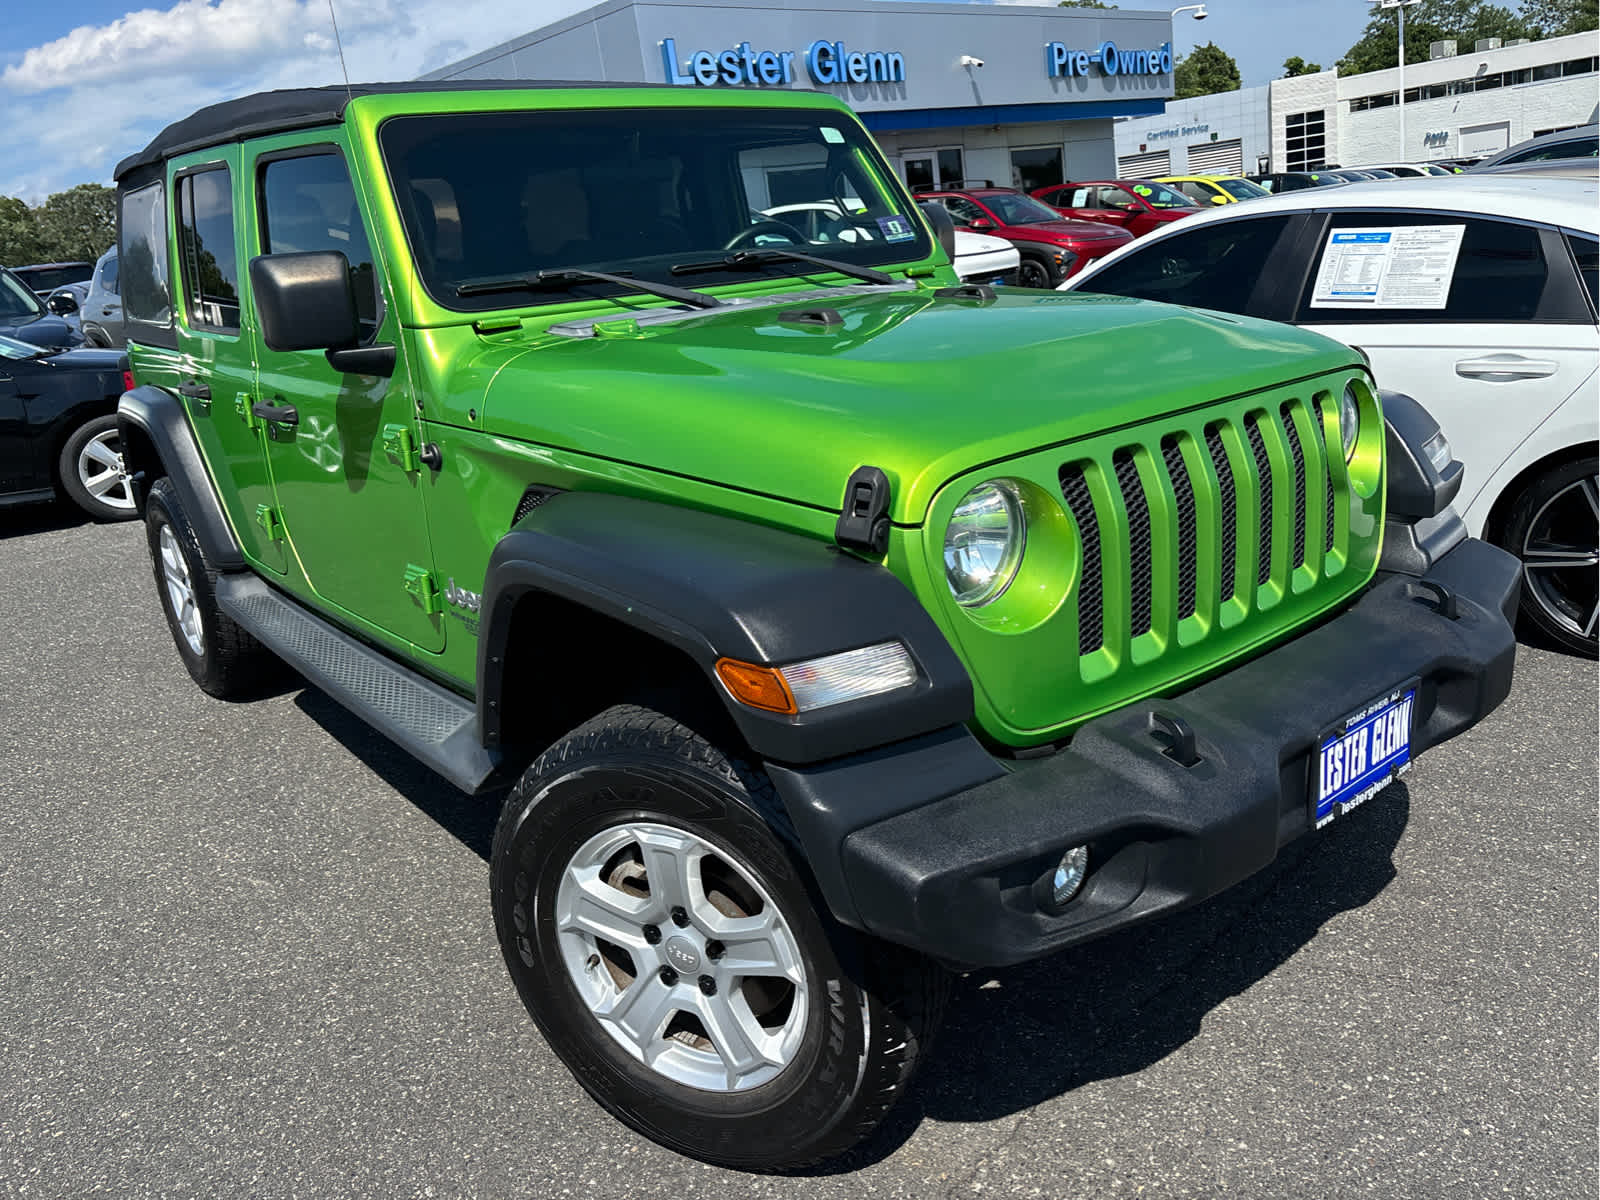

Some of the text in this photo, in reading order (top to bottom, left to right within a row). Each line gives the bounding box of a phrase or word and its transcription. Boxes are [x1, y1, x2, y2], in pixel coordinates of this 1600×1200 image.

[662, 38, 906, 87] Lester Glenn
[1047, 41, 1173, 77] Pre-Owned
[1146, 124, 1209, 141] Certified Service
[1345, 710, 1368, 729] TOMS
[1390, 689, 1401, 703] NJ
[1318, 699, 1412, 802] LESTER GLENN
[1340, 773, 1393, 816] lesterglenn
